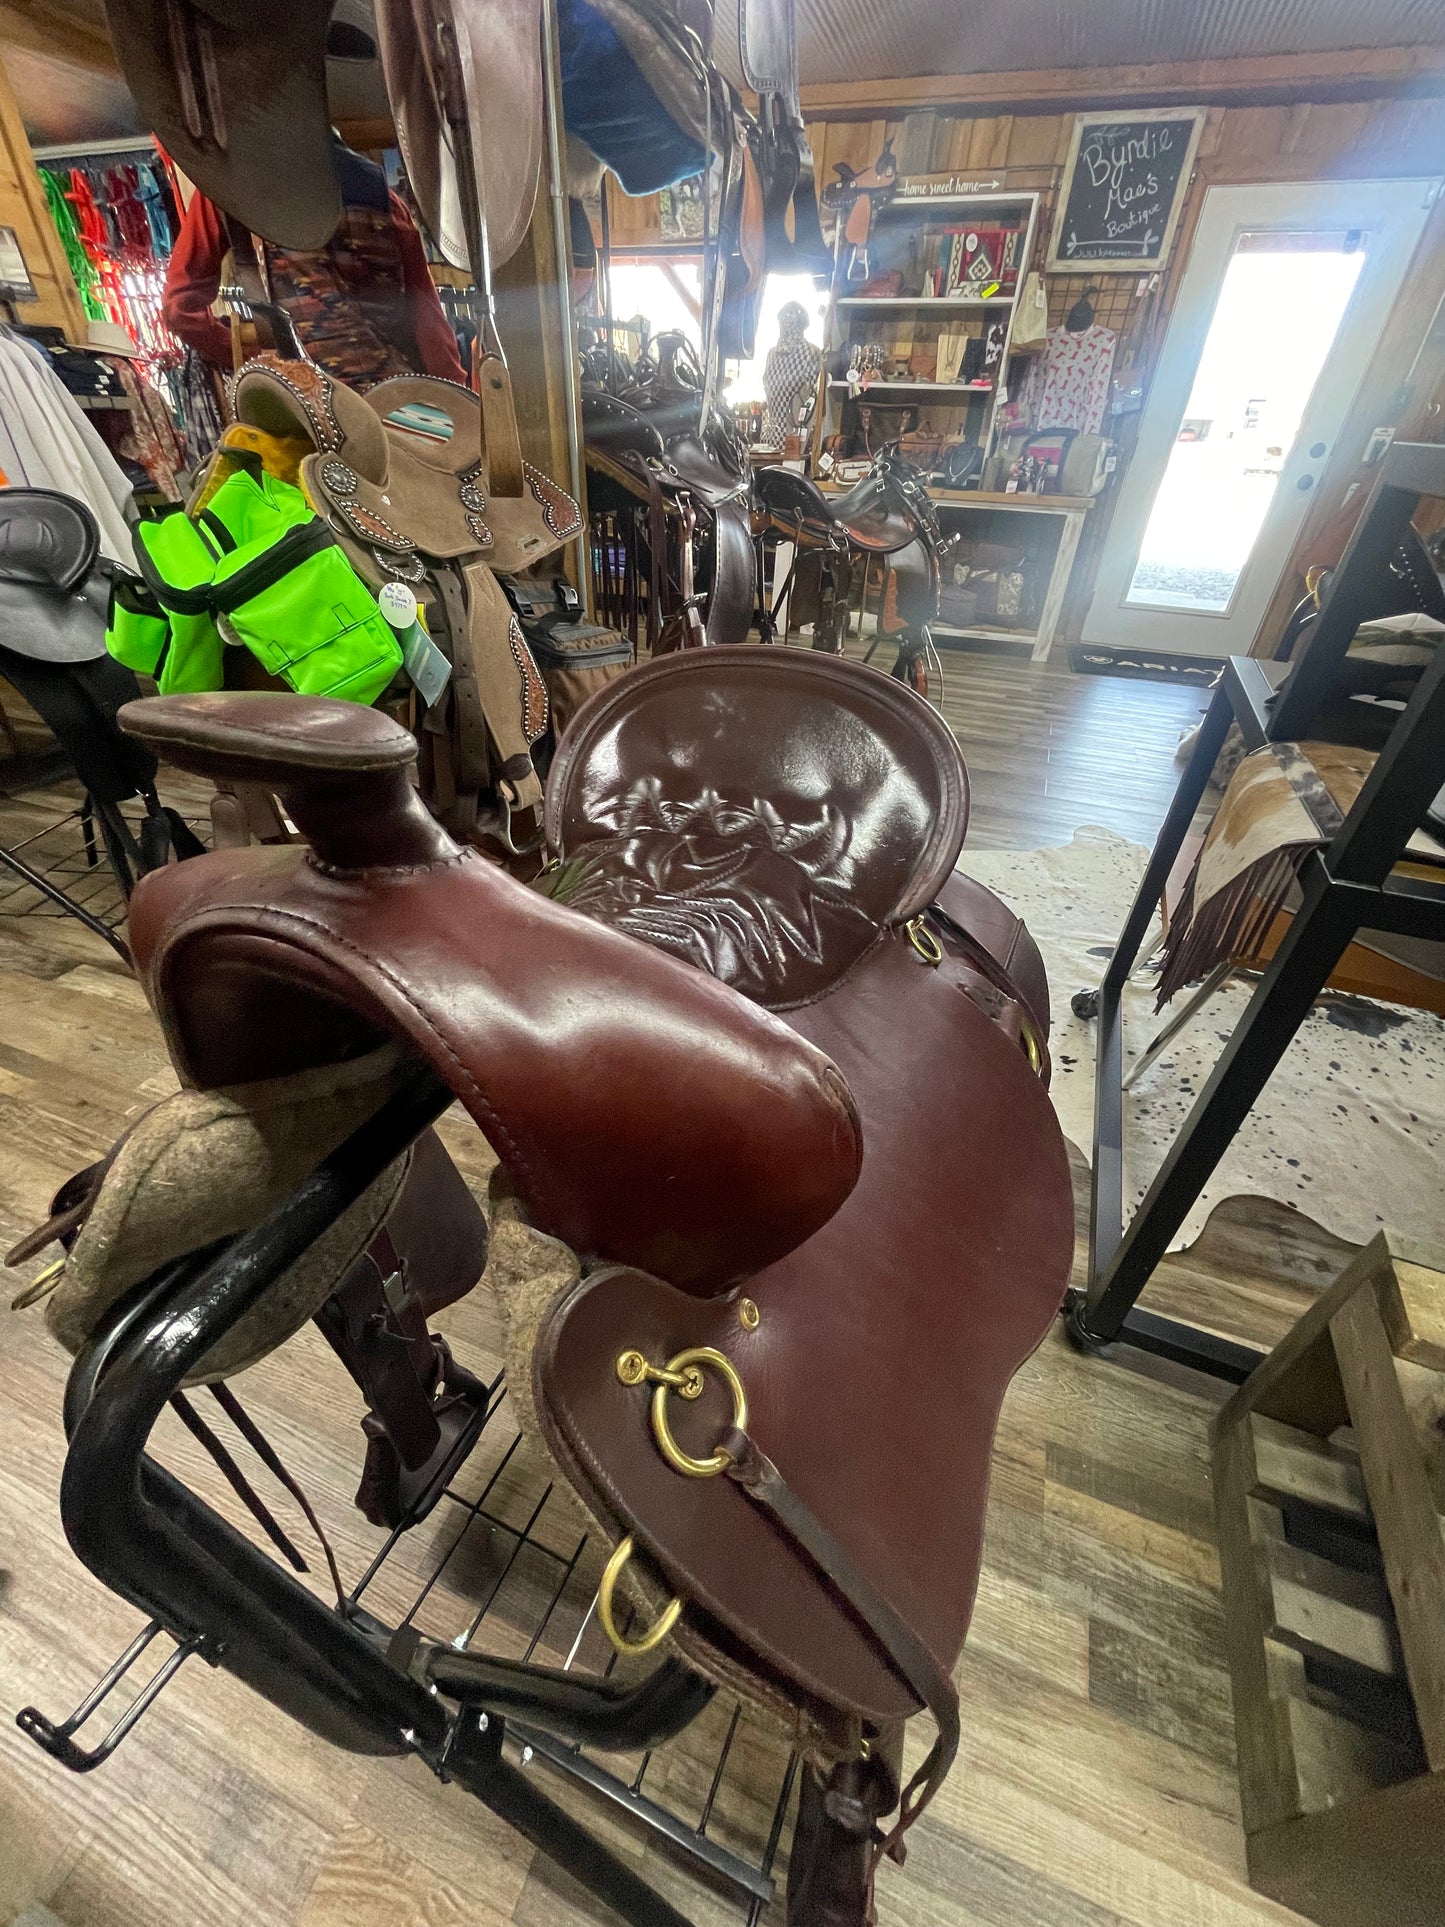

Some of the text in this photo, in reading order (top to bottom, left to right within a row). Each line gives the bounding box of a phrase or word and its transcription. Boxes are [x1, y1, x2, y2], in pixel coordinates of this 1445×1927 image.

[1083, 127, 1173, 189] Byrdie
[904, 176, 980, 196] home sweet home
[1104, 173, 1159, 220] Mae's
[1106, 203, 1161, 238] Boutique
